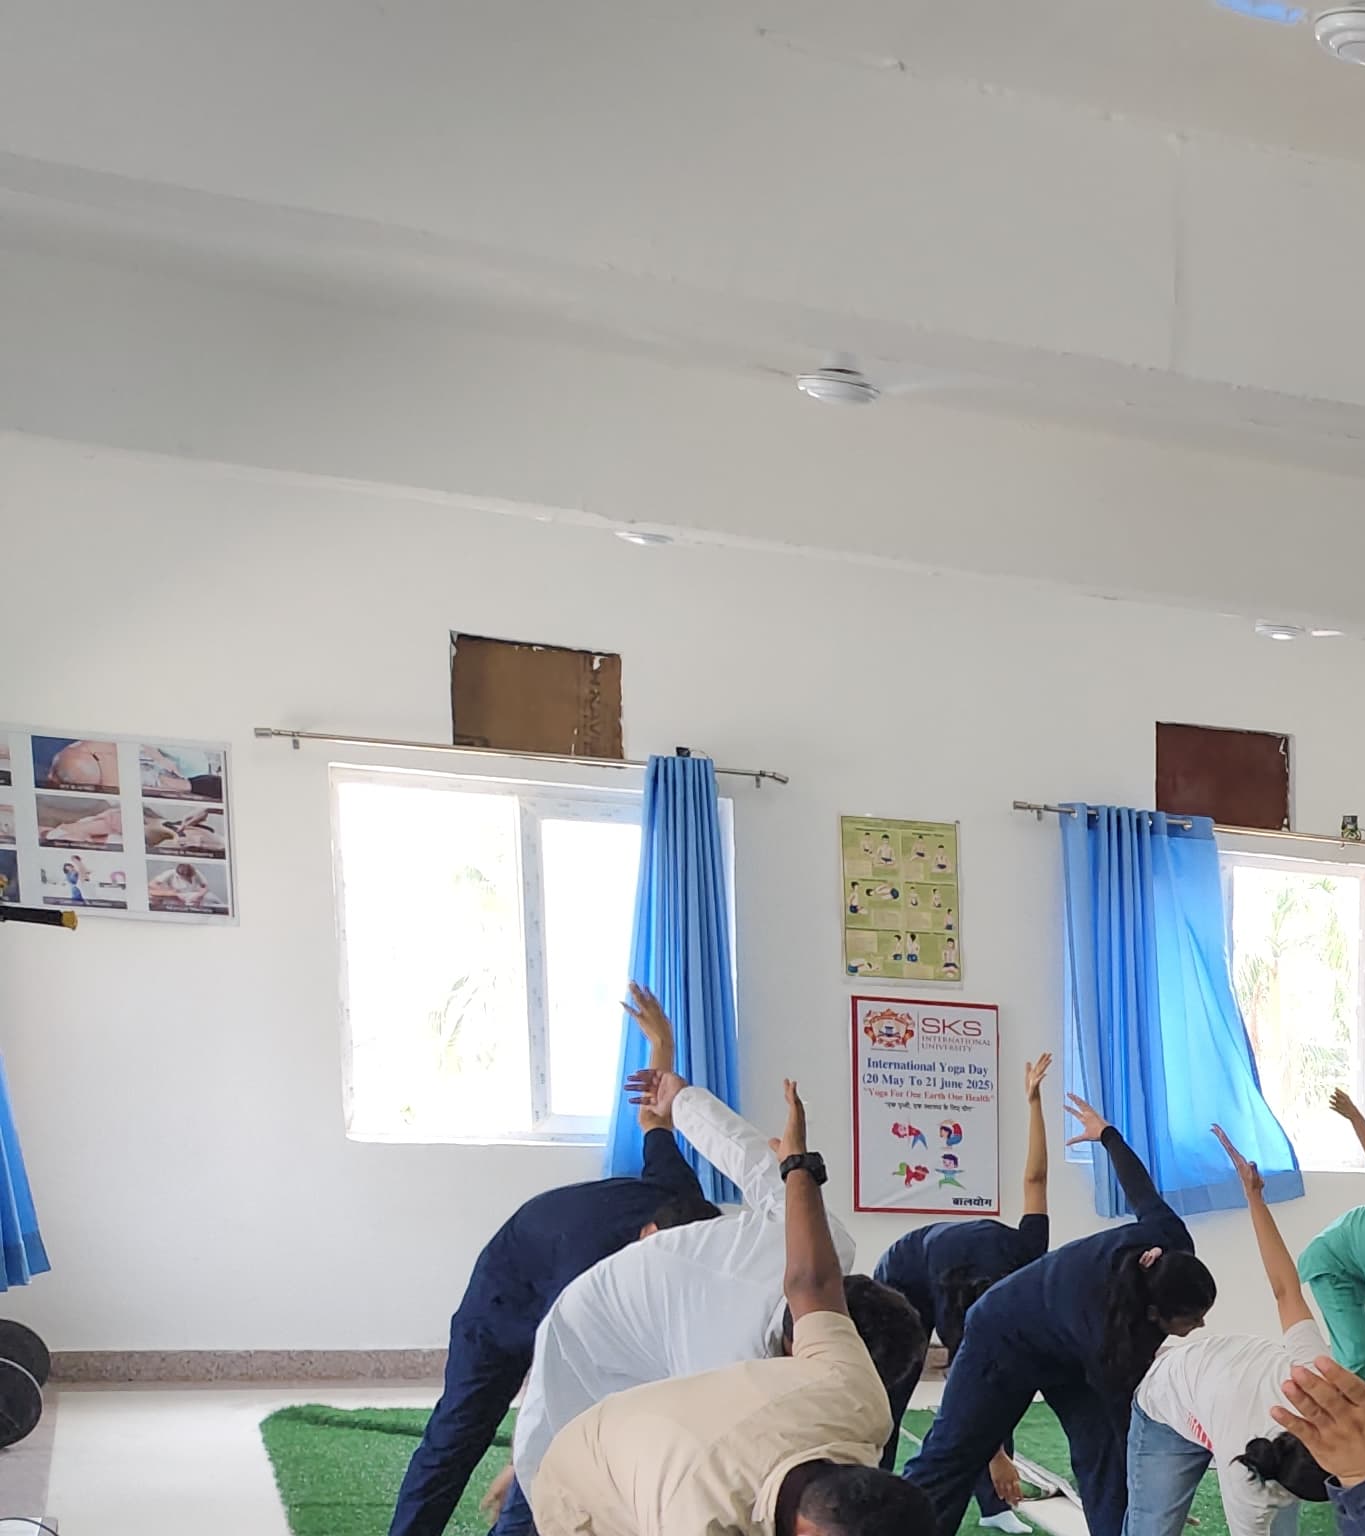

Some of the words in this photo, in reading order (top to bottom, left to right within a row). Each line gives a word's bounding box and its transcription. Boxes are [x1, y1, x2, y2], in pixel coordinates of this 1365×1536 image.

[921, 1017, 982, 1037] SKS
[922, 1035, 991, 1047] INTERNATIONAL
[922, 1042, 972, 1053] UNIVERSITY
[867, 1057, 936, 1073] International
[939, 1061, 966, 1076] Yoga
[968, 1063, 988, 1078] Day
[862, 1073, 879, 1085] (20
[882, 1074, 904, 1088] May
[908, 1075, 923, 1086] To
[925, 1076, 937, 1088] 21
[966, 1079, 994, 1092] 2025)
[923, 1091, 946, 1100] Earth
